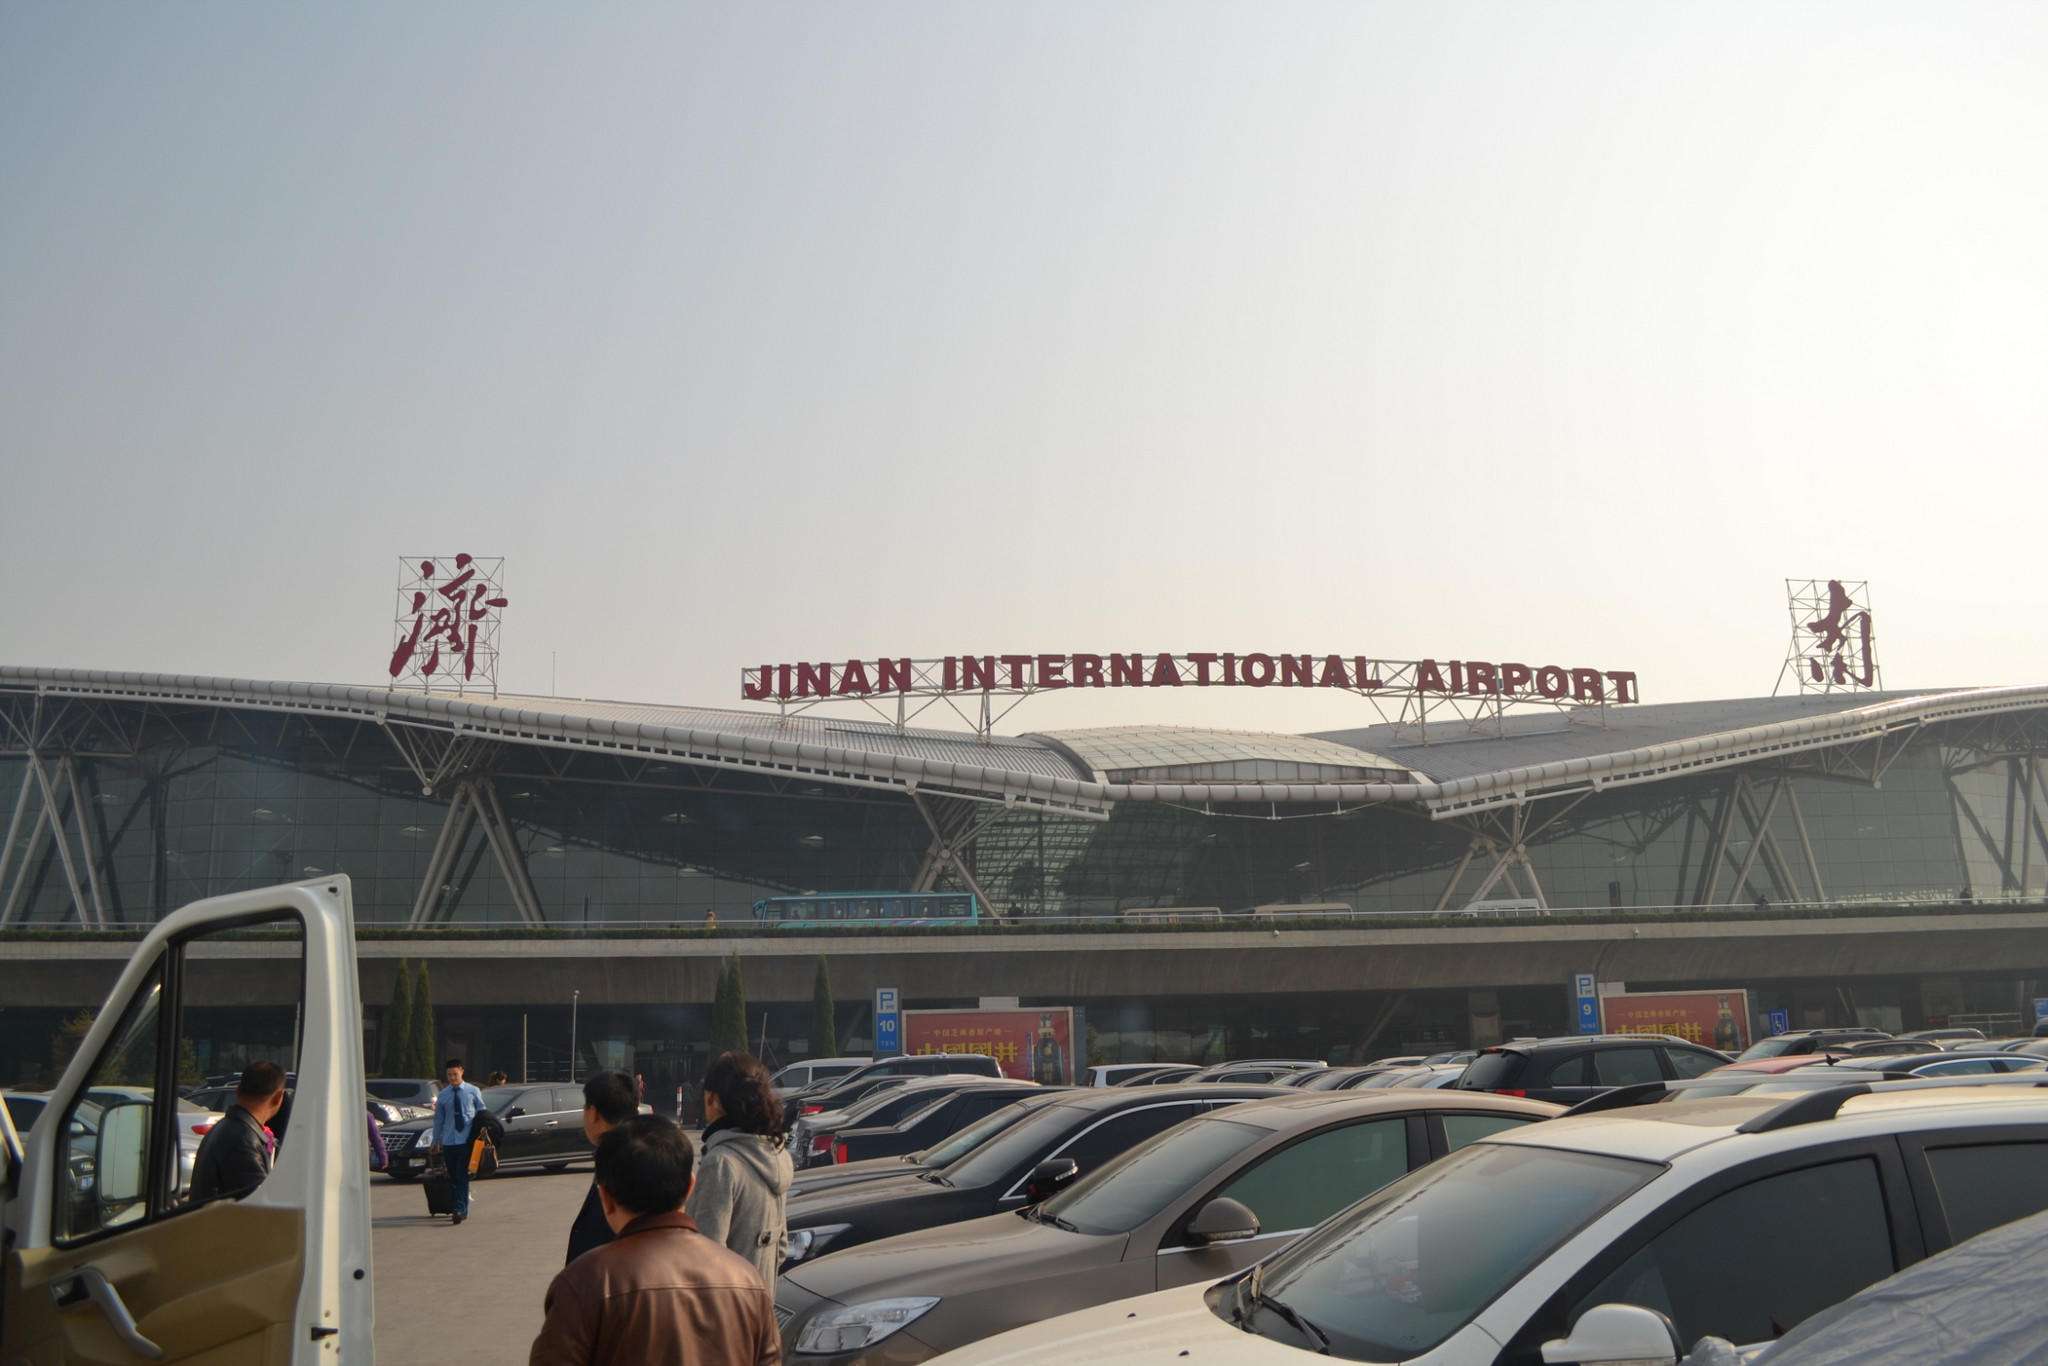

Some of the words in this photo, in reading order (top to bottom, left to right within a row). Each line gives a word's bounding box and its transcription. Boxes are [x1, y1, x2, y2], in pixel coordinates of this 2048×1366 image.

[744, 657, 912, 701] JINAN
[943, 652, 1383, 691] INTERNATIONAL
[1416, 659, 1637, 704] AIRPORT
[1583, 1003, 1592, 1016] 9
[879, 1019, 896, 1033] 10
